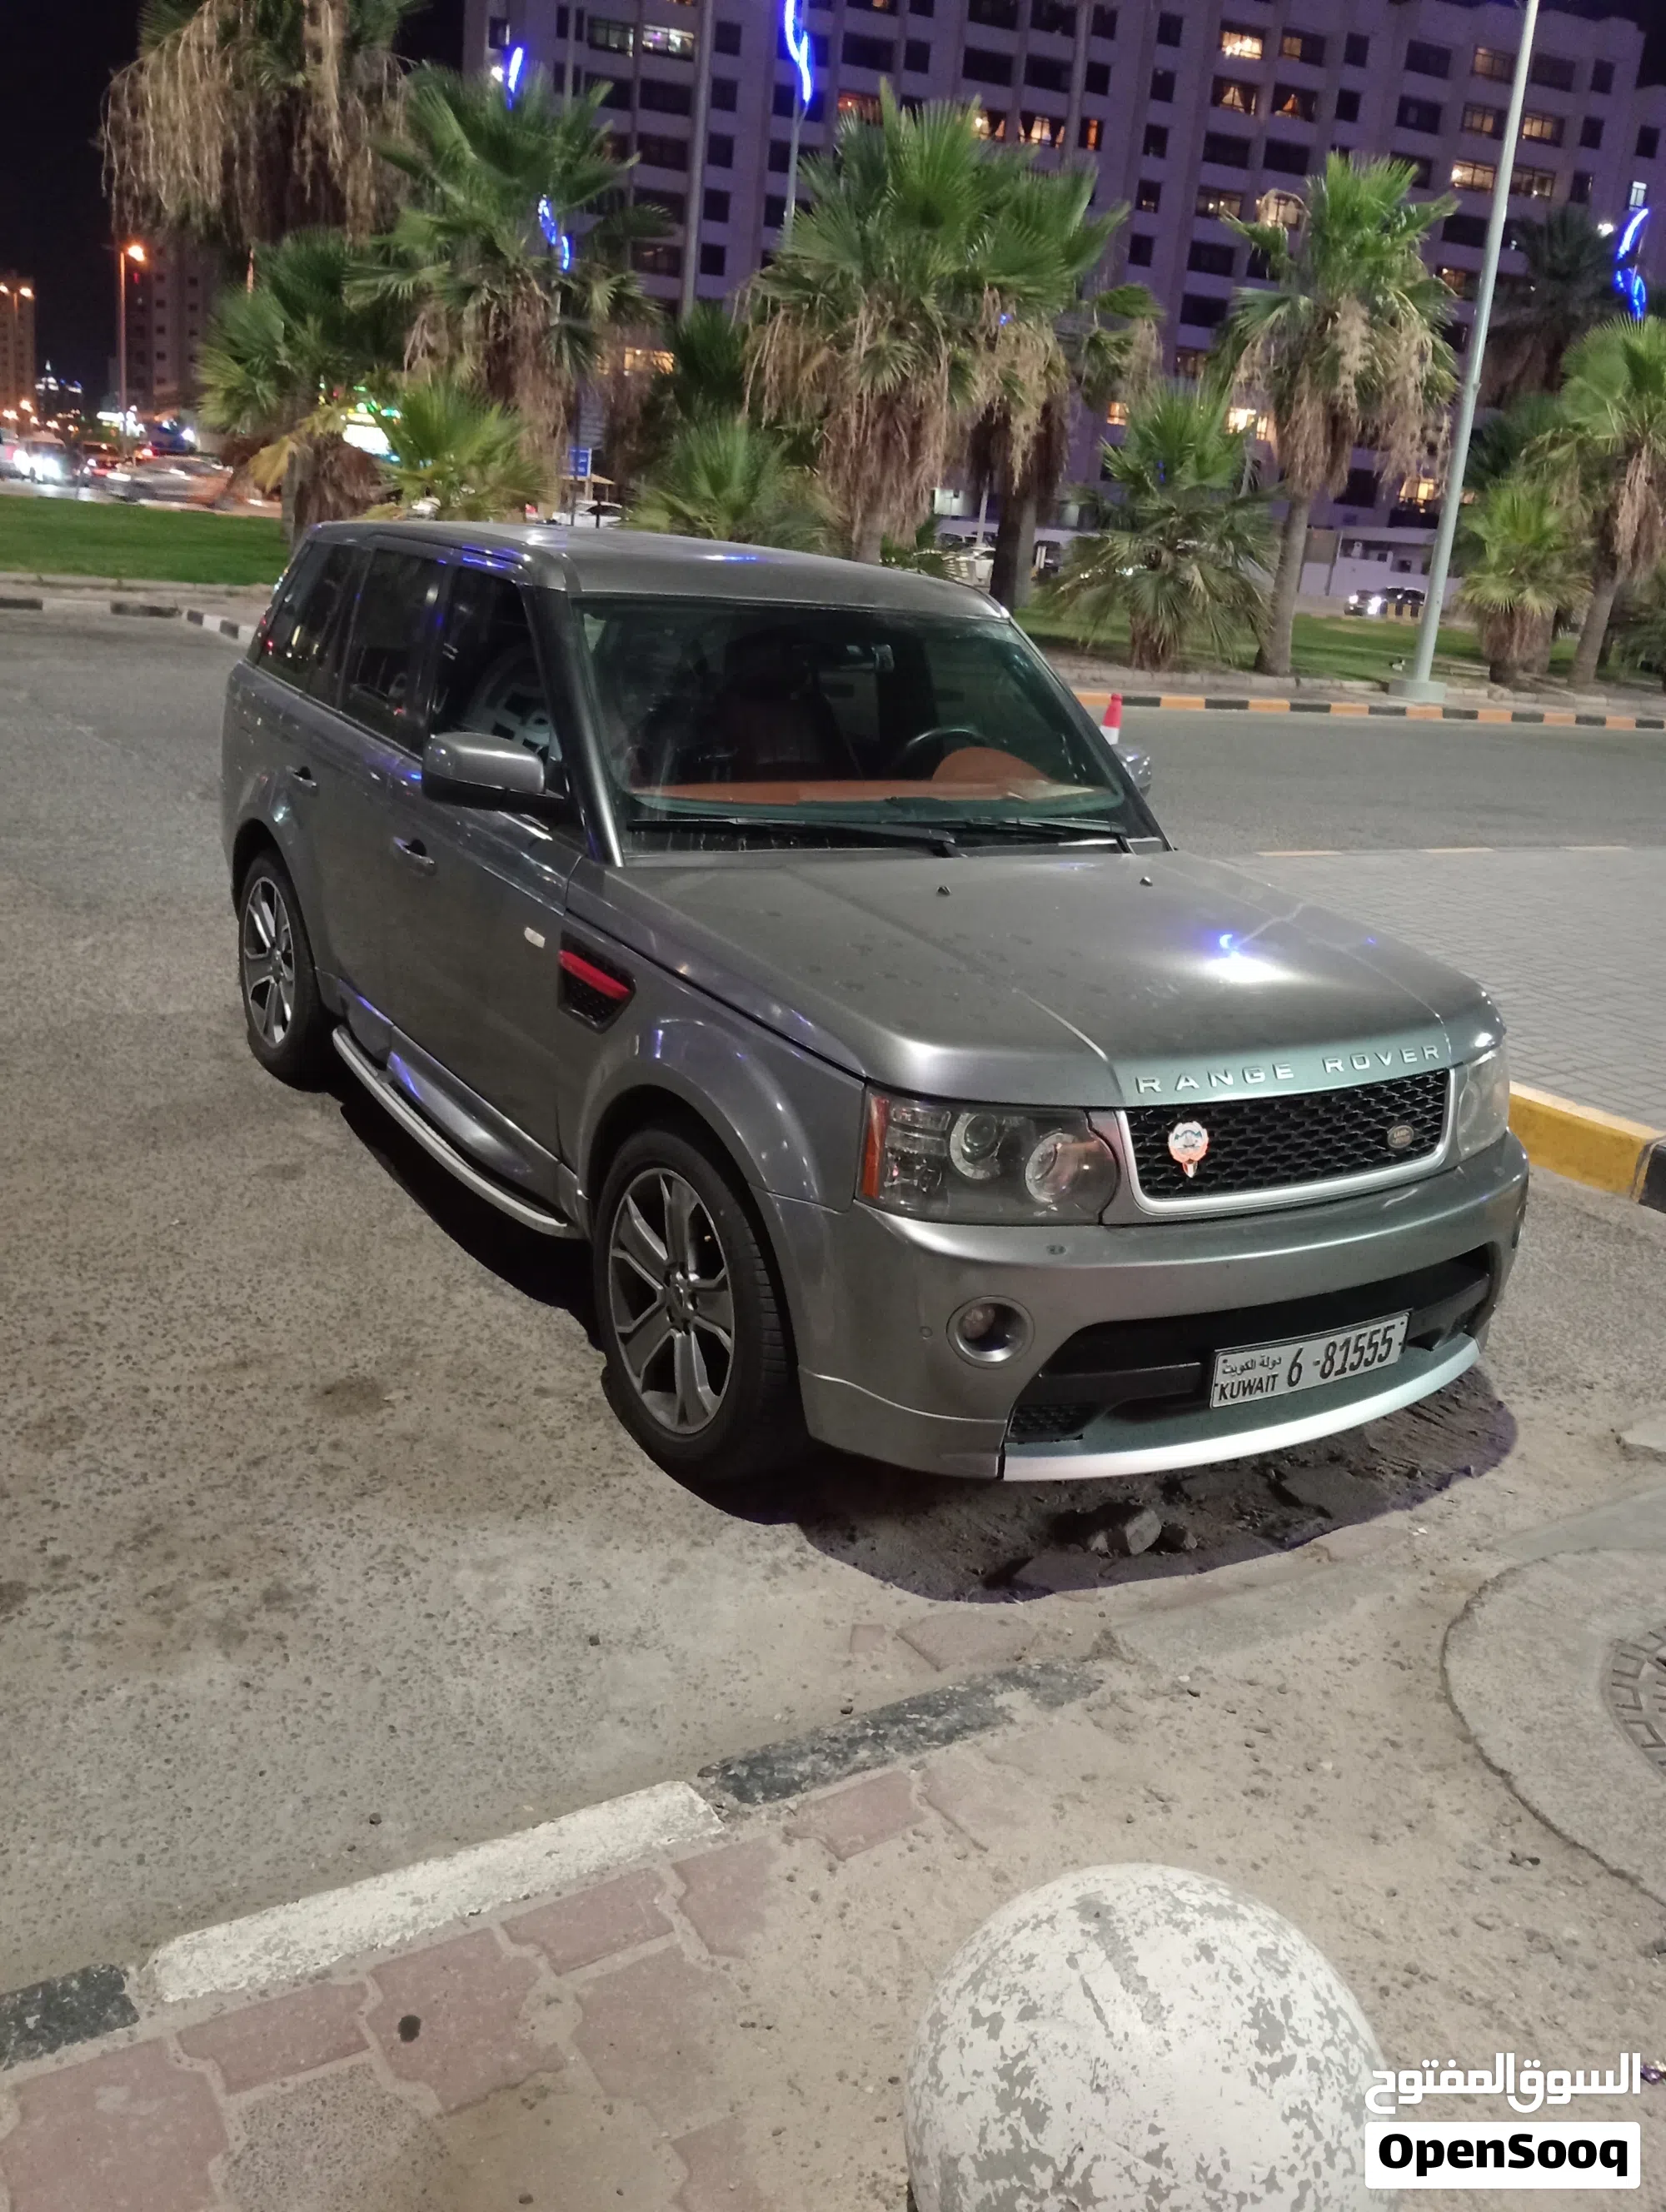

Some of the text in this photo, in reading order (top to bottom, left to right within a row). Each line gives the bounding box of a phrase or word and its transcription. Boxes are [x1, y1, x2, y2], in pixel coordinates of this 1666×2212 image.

[1135, 1044, 1439, 1094] RANGE ROVER
[1222, 1354, 1281, 1377] دولة الكويت
[1219, 1373, 1279, 1401] KUWAIT
